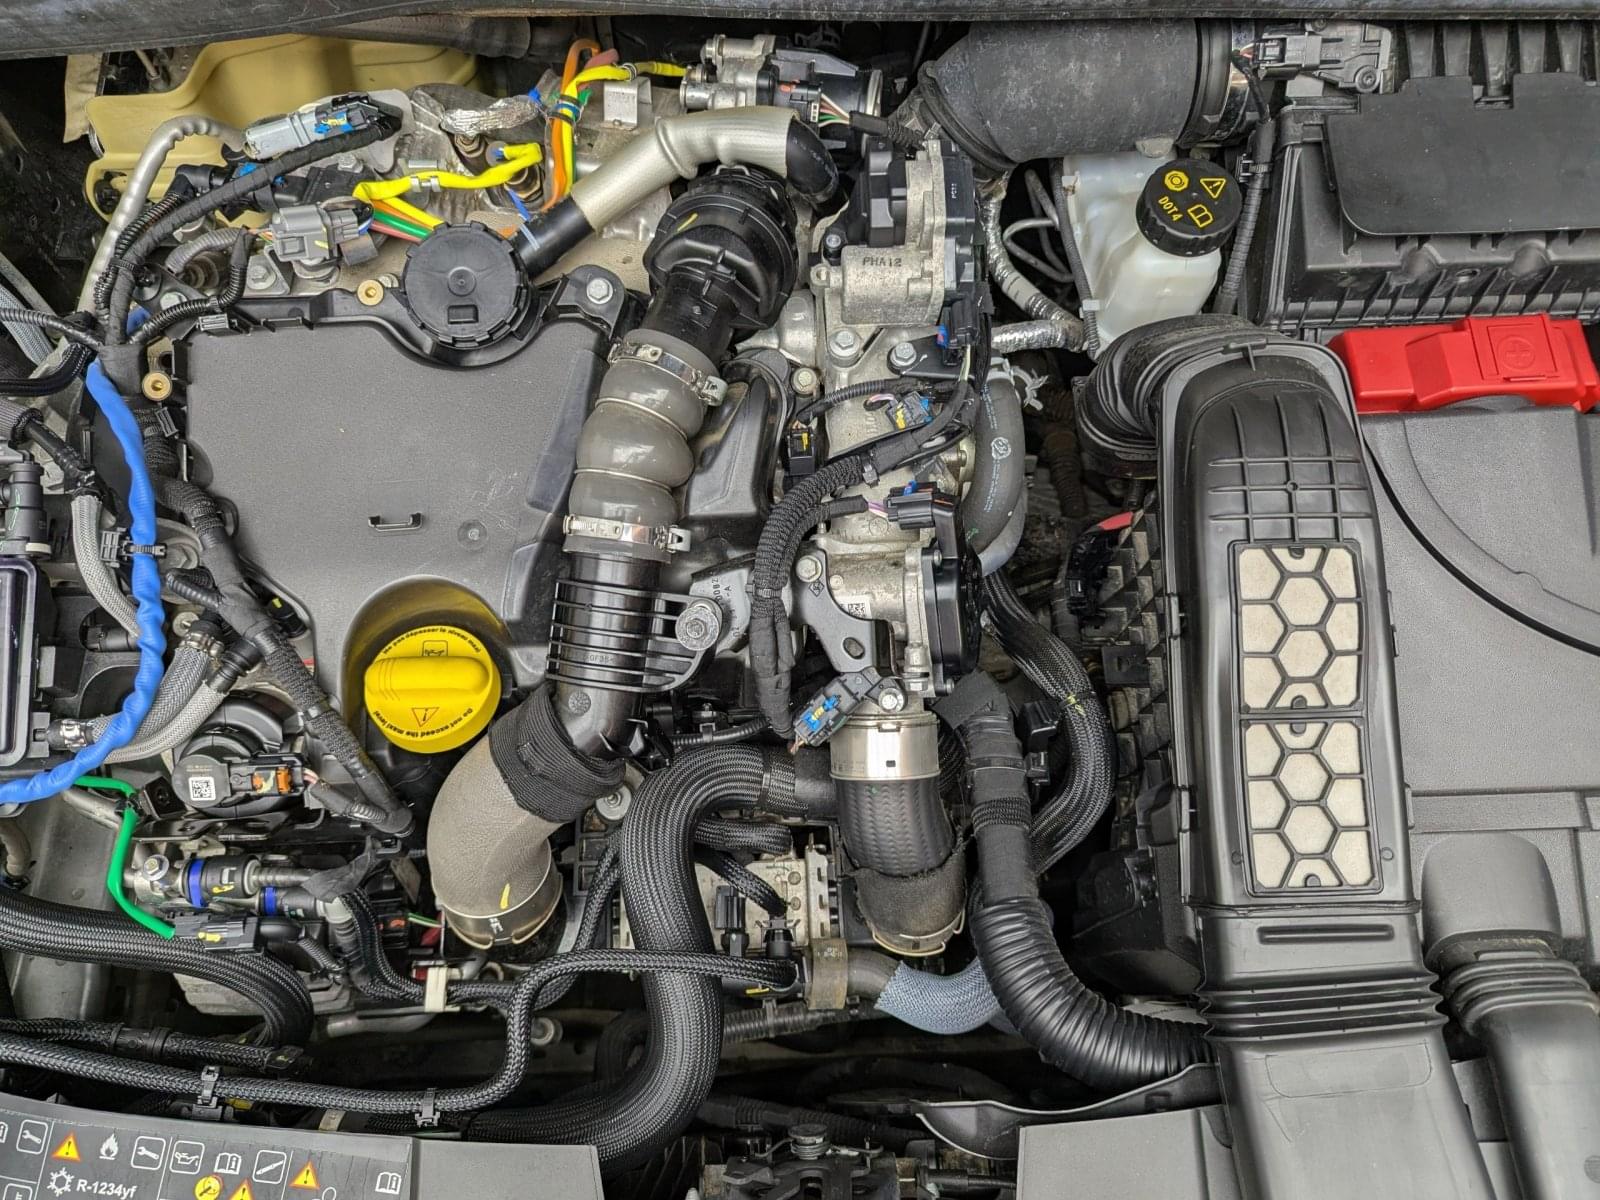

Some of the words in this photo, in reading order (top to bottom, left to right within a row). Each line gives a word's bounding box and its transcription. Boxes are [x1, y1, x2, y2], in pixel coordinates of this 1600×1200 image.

[373, 710, 388, 726] level
[462, 708, 473, 717] Do
[450, 717, 463, 728] not
[385, 723, 405, 735] maxi
[405, 730, 419, 738] the
[420, 725, 450, 738] exceed
[76, 1179, 138, 1200] R-1234yf
